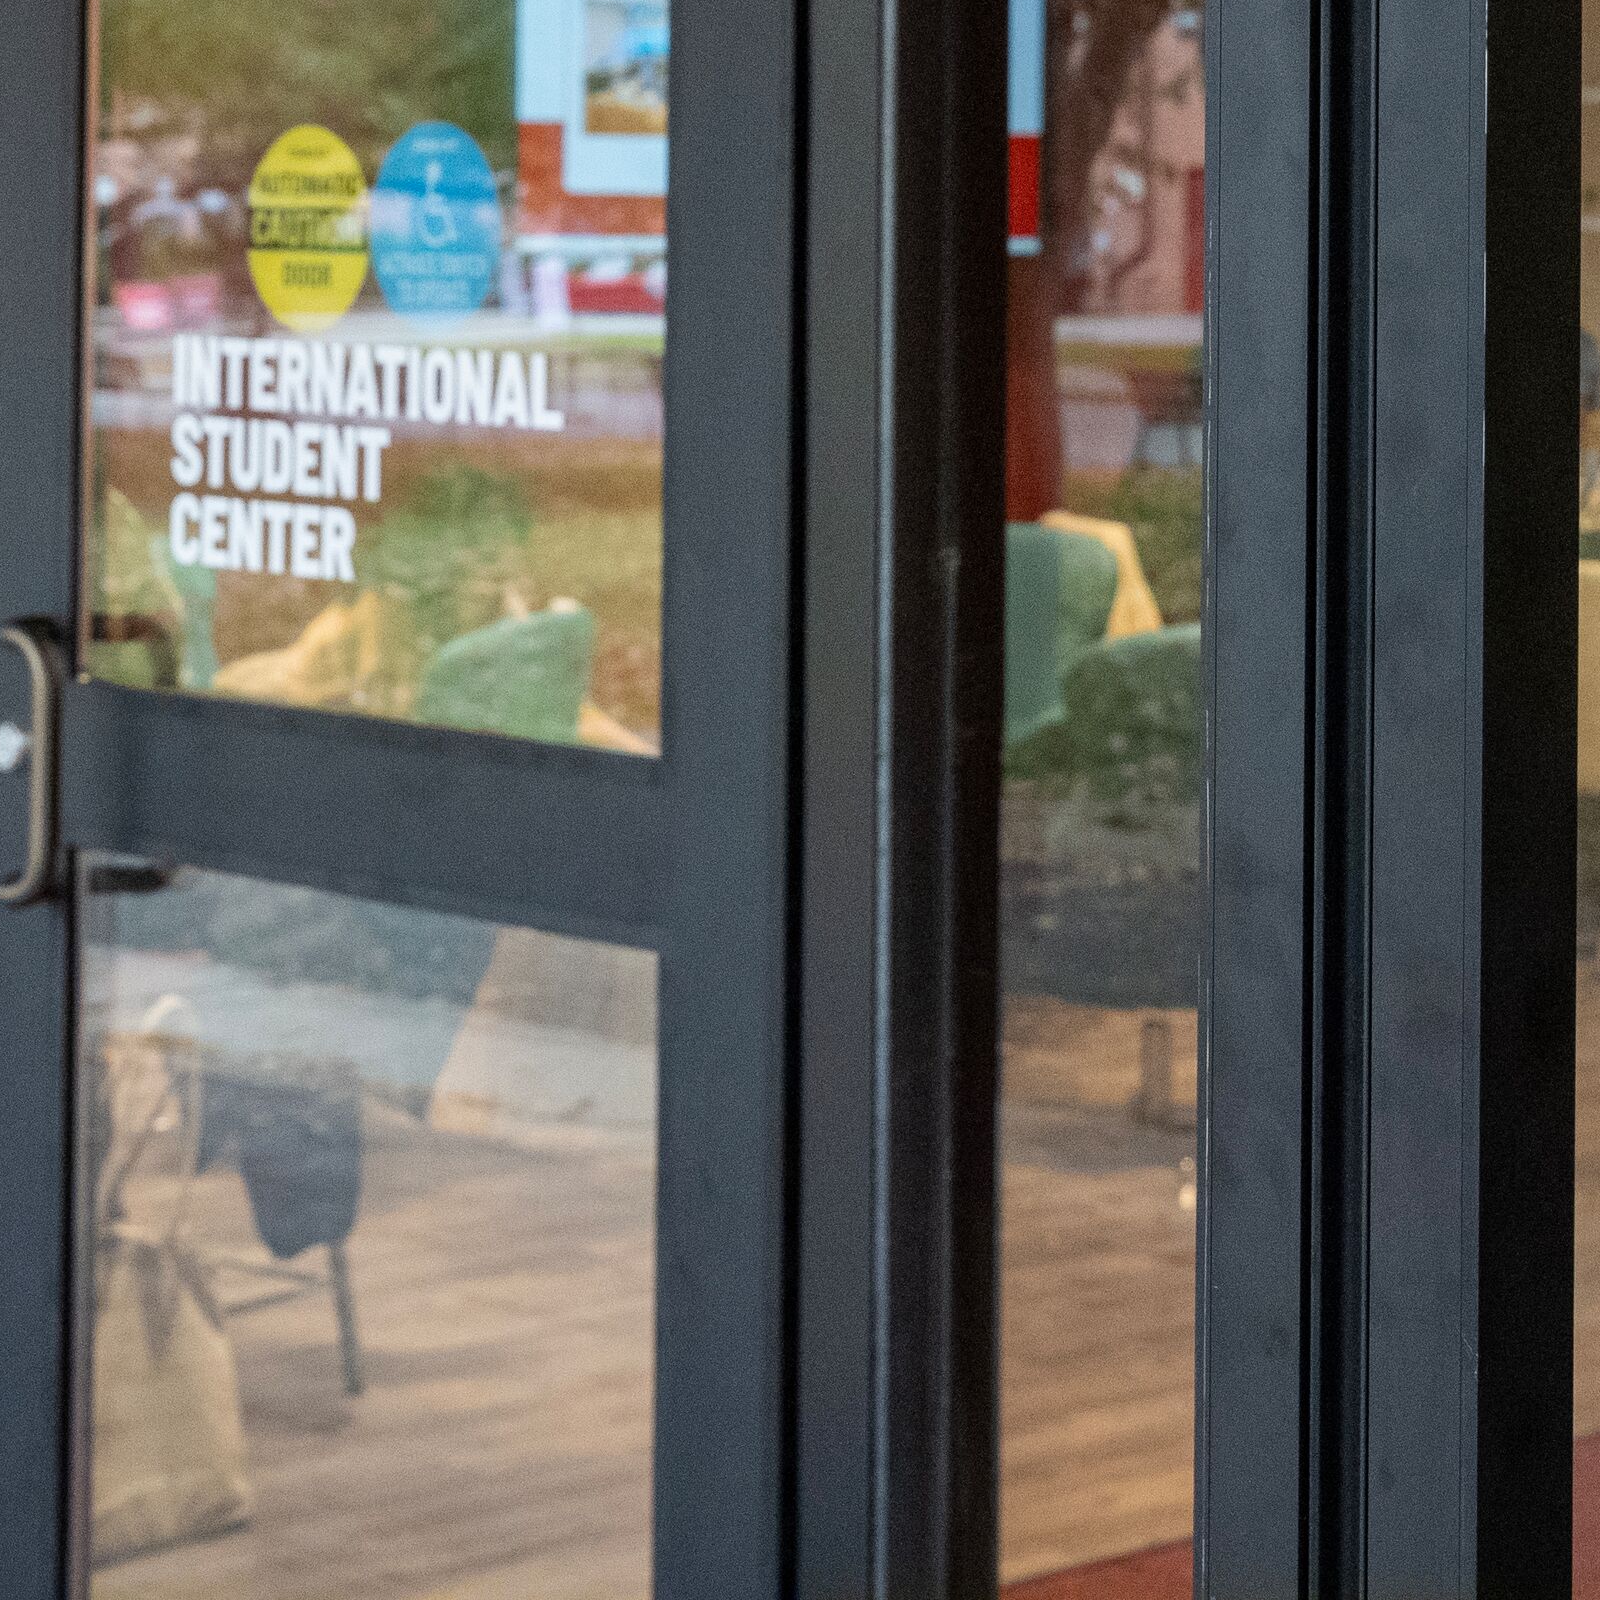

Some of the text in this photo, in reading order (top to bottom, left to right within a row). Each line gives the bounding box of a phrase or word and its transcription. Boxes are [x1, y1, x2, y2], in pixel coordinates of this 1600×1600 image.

[173, 334, 564, 431] INTERNATIONAL
[170, 413, 390, 503] STUDENT
[169, 492, 356, 582] CENTER
